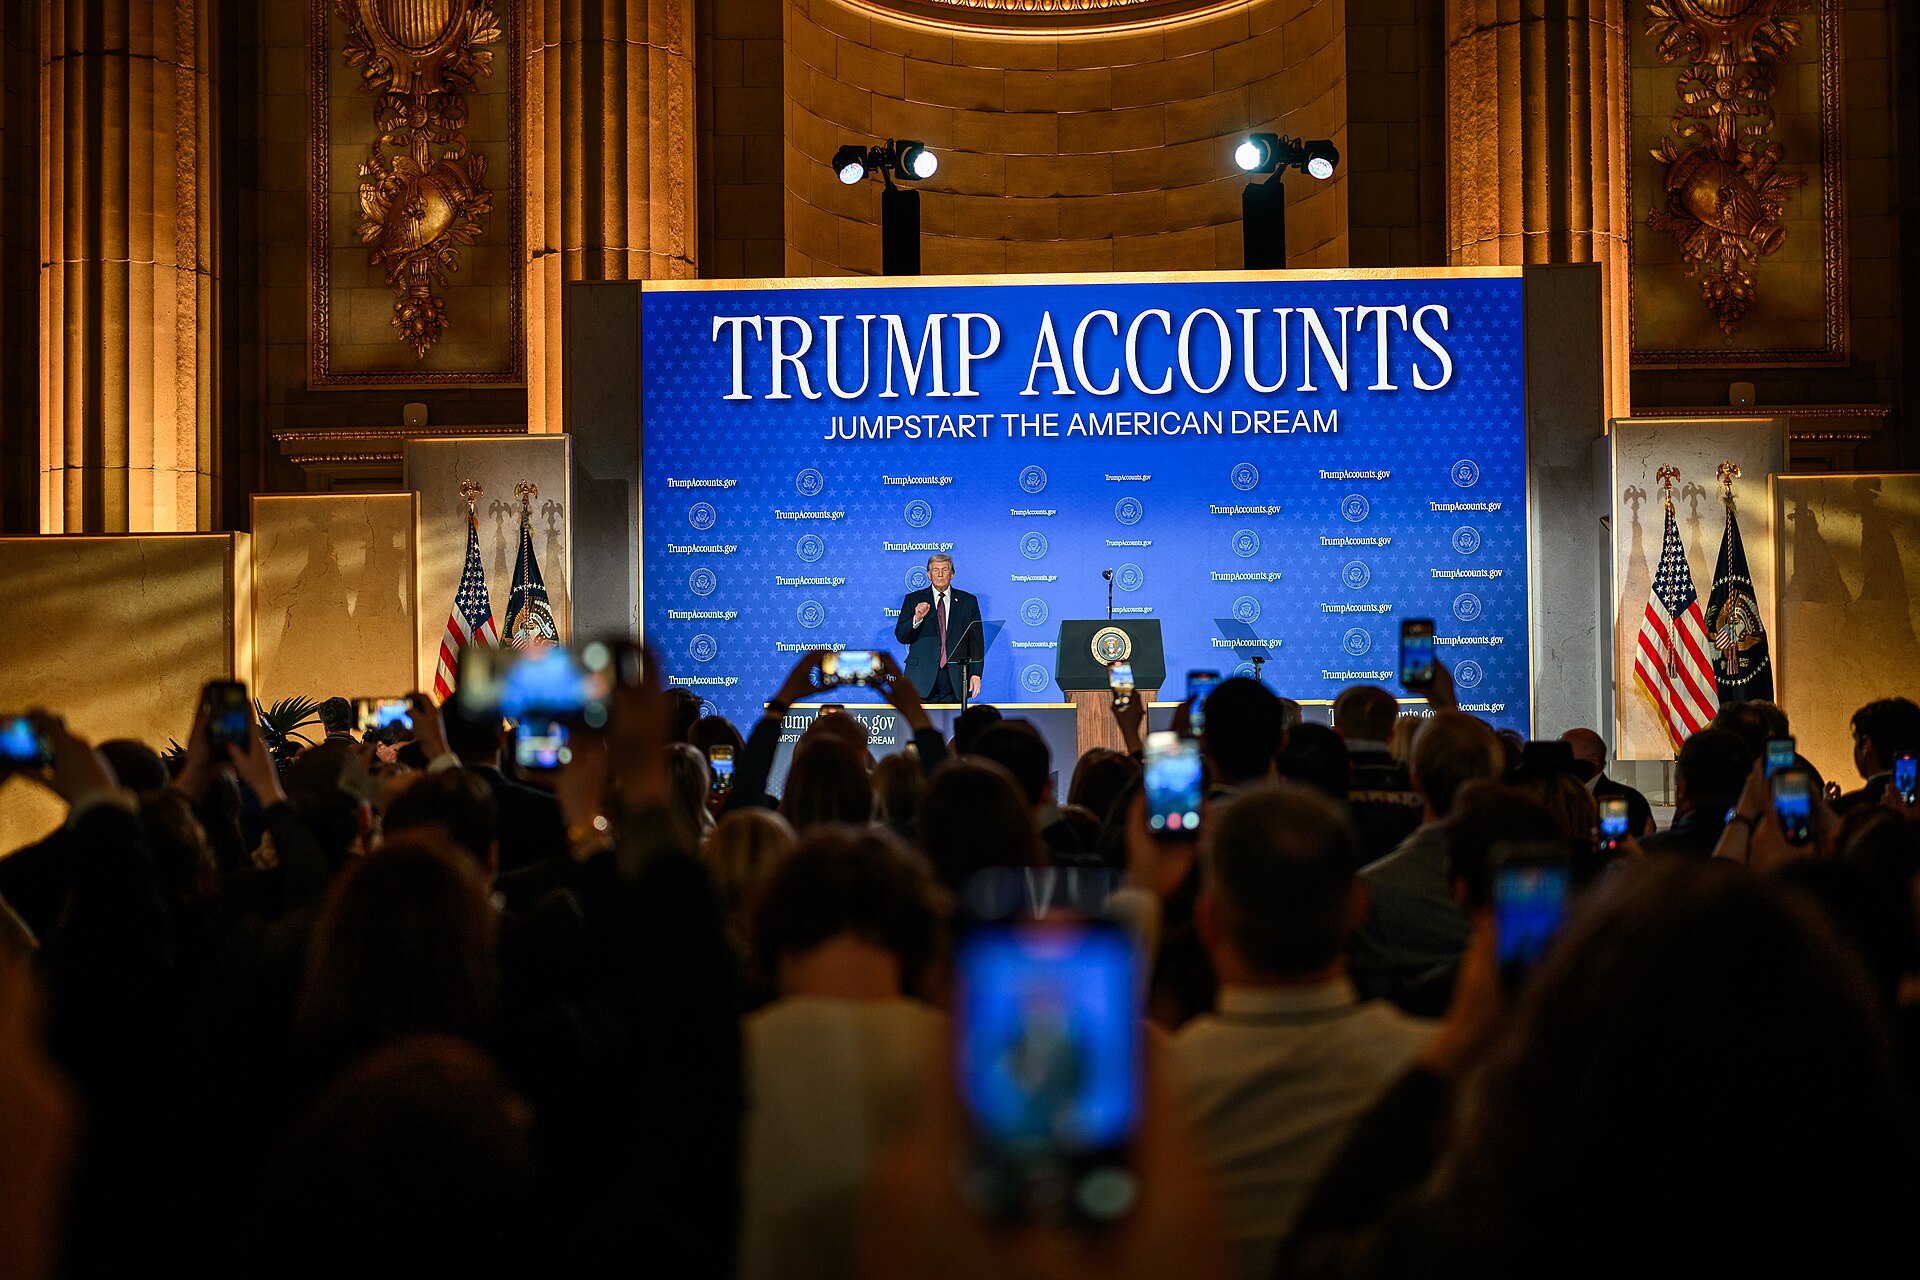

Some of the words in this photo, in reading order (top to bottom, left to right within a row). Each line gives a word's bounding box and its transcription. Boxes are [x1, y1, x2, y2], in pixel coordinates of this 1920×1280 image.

[713, 313, 1000, 399] TRUMP
[1020, 305, 1452, 395] ACCOUNTS
[825, 414, 994, 439] JUMPSTART
[1001, 414, 1058, 436] THE
[1067, 411, 1222, 436] AMERICAN
[1232, 410, 1337, 433] DREAM
[882, 475, 953, 487] TrumpAccounts.gov
[1104, 474, 1152, 482] TrumpAccounts.gov
[1318, 469, 1390, 481] TrumpAccounts.gov
[667, 477, 737, 489] TrumpAccounts.gov
[1010, 508, 1057, 517] TrumpAccounts.gov
[1209, 504, 1281, 516] TrumpAccounts.gov
[1429, 501, 1501, 513] TrumpAccounts.gov
[774, 509, 845, 521] TrumpAccounts.gov
[882, 541, 954, 553] TrumpAccounts.gov
[1105, 539, 1152, 548] TrumpAccounts.gov
[1319, 536, 1392, 548] TrumpAccounts.gov
[667, 543, 737, 555] TrumpAccounts.gov
[1010, 574, 1058, 583] TrumpAccounts.gov
[1210, 571, 1281, 583] TrumpAccounts.gov
[1430, 568, 1503, 580] TrumpAccounts.gov
[775, 575, 846, 587] TrumpAccounts.gov
[1320, 602, 1393, 614] TrumpAccounts.gov
[667, 609, 738, 621] TrumpAccounts.gov
[1011, 640, 1058, 649] TrumpAccounts.gov
[1210, 637, 1282, 649] TrumpAccounts.gov
[1432, 635, 1504, 647] TrumpAccounts.gov
[775, 641, 847, 654] TrumpAccounts.gov
[668, 675, 738, 687] TrumpAccounts.gov
[1321, 669, 1394, 681] TrumpAccounts.gov
[867, 735, 895, 745] DREAM
